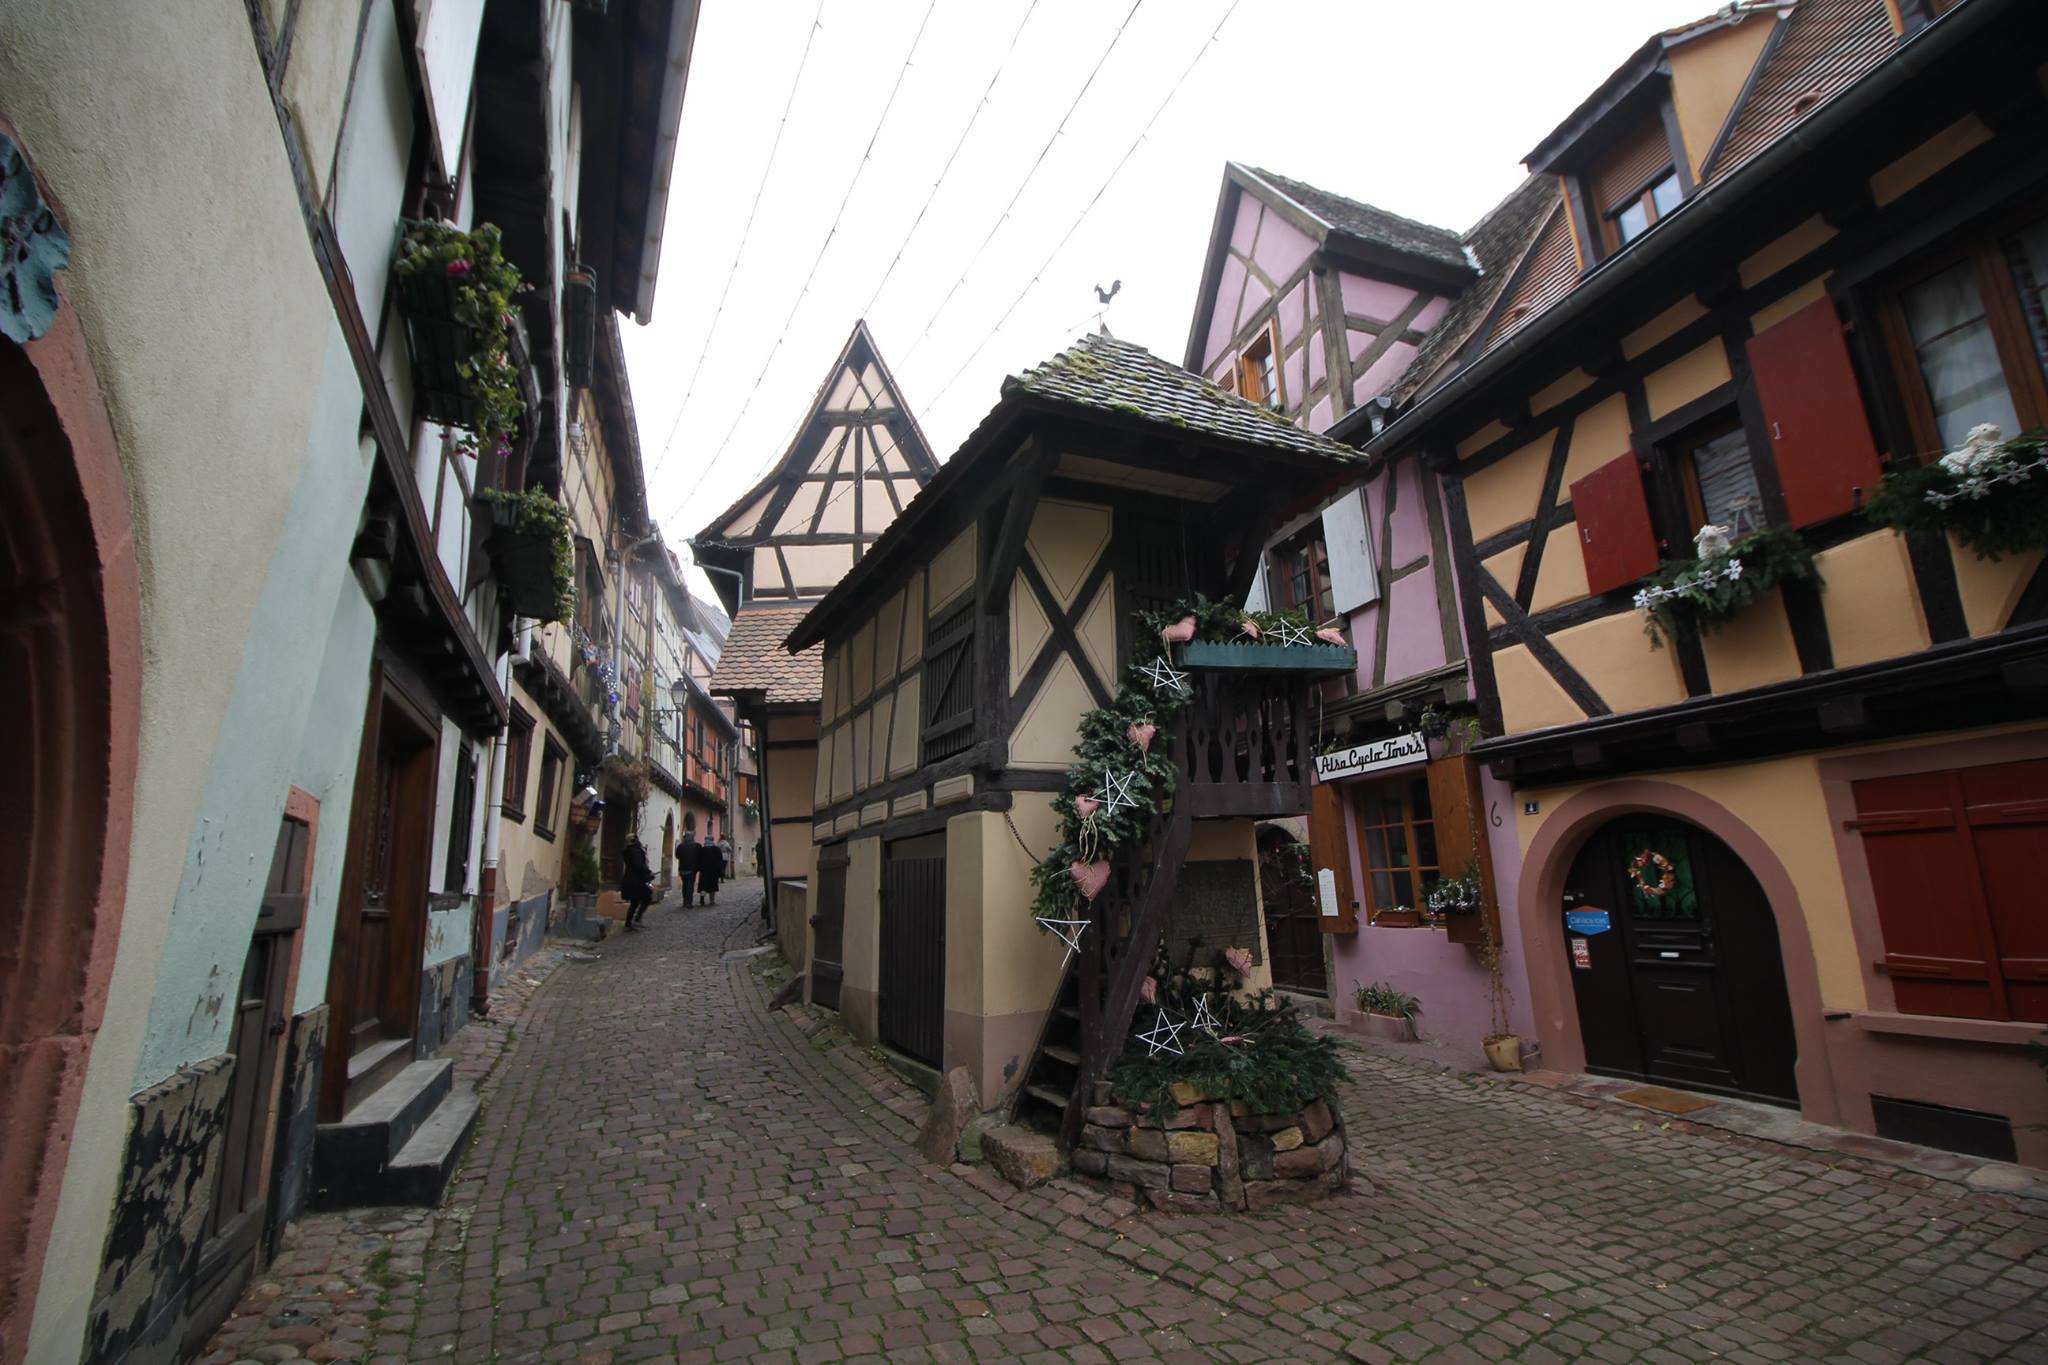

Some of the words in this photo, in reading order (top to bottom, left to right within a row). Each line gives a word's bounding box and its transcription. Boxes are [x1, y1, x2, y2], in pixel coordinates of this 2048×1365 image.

[1320, 756, 1347, 775] Alsa
[1348, 749, 1384, 771] Cyclo
[1383, 740, 1425, 761] Tours
[1490, 800, 1503, 828] 6
